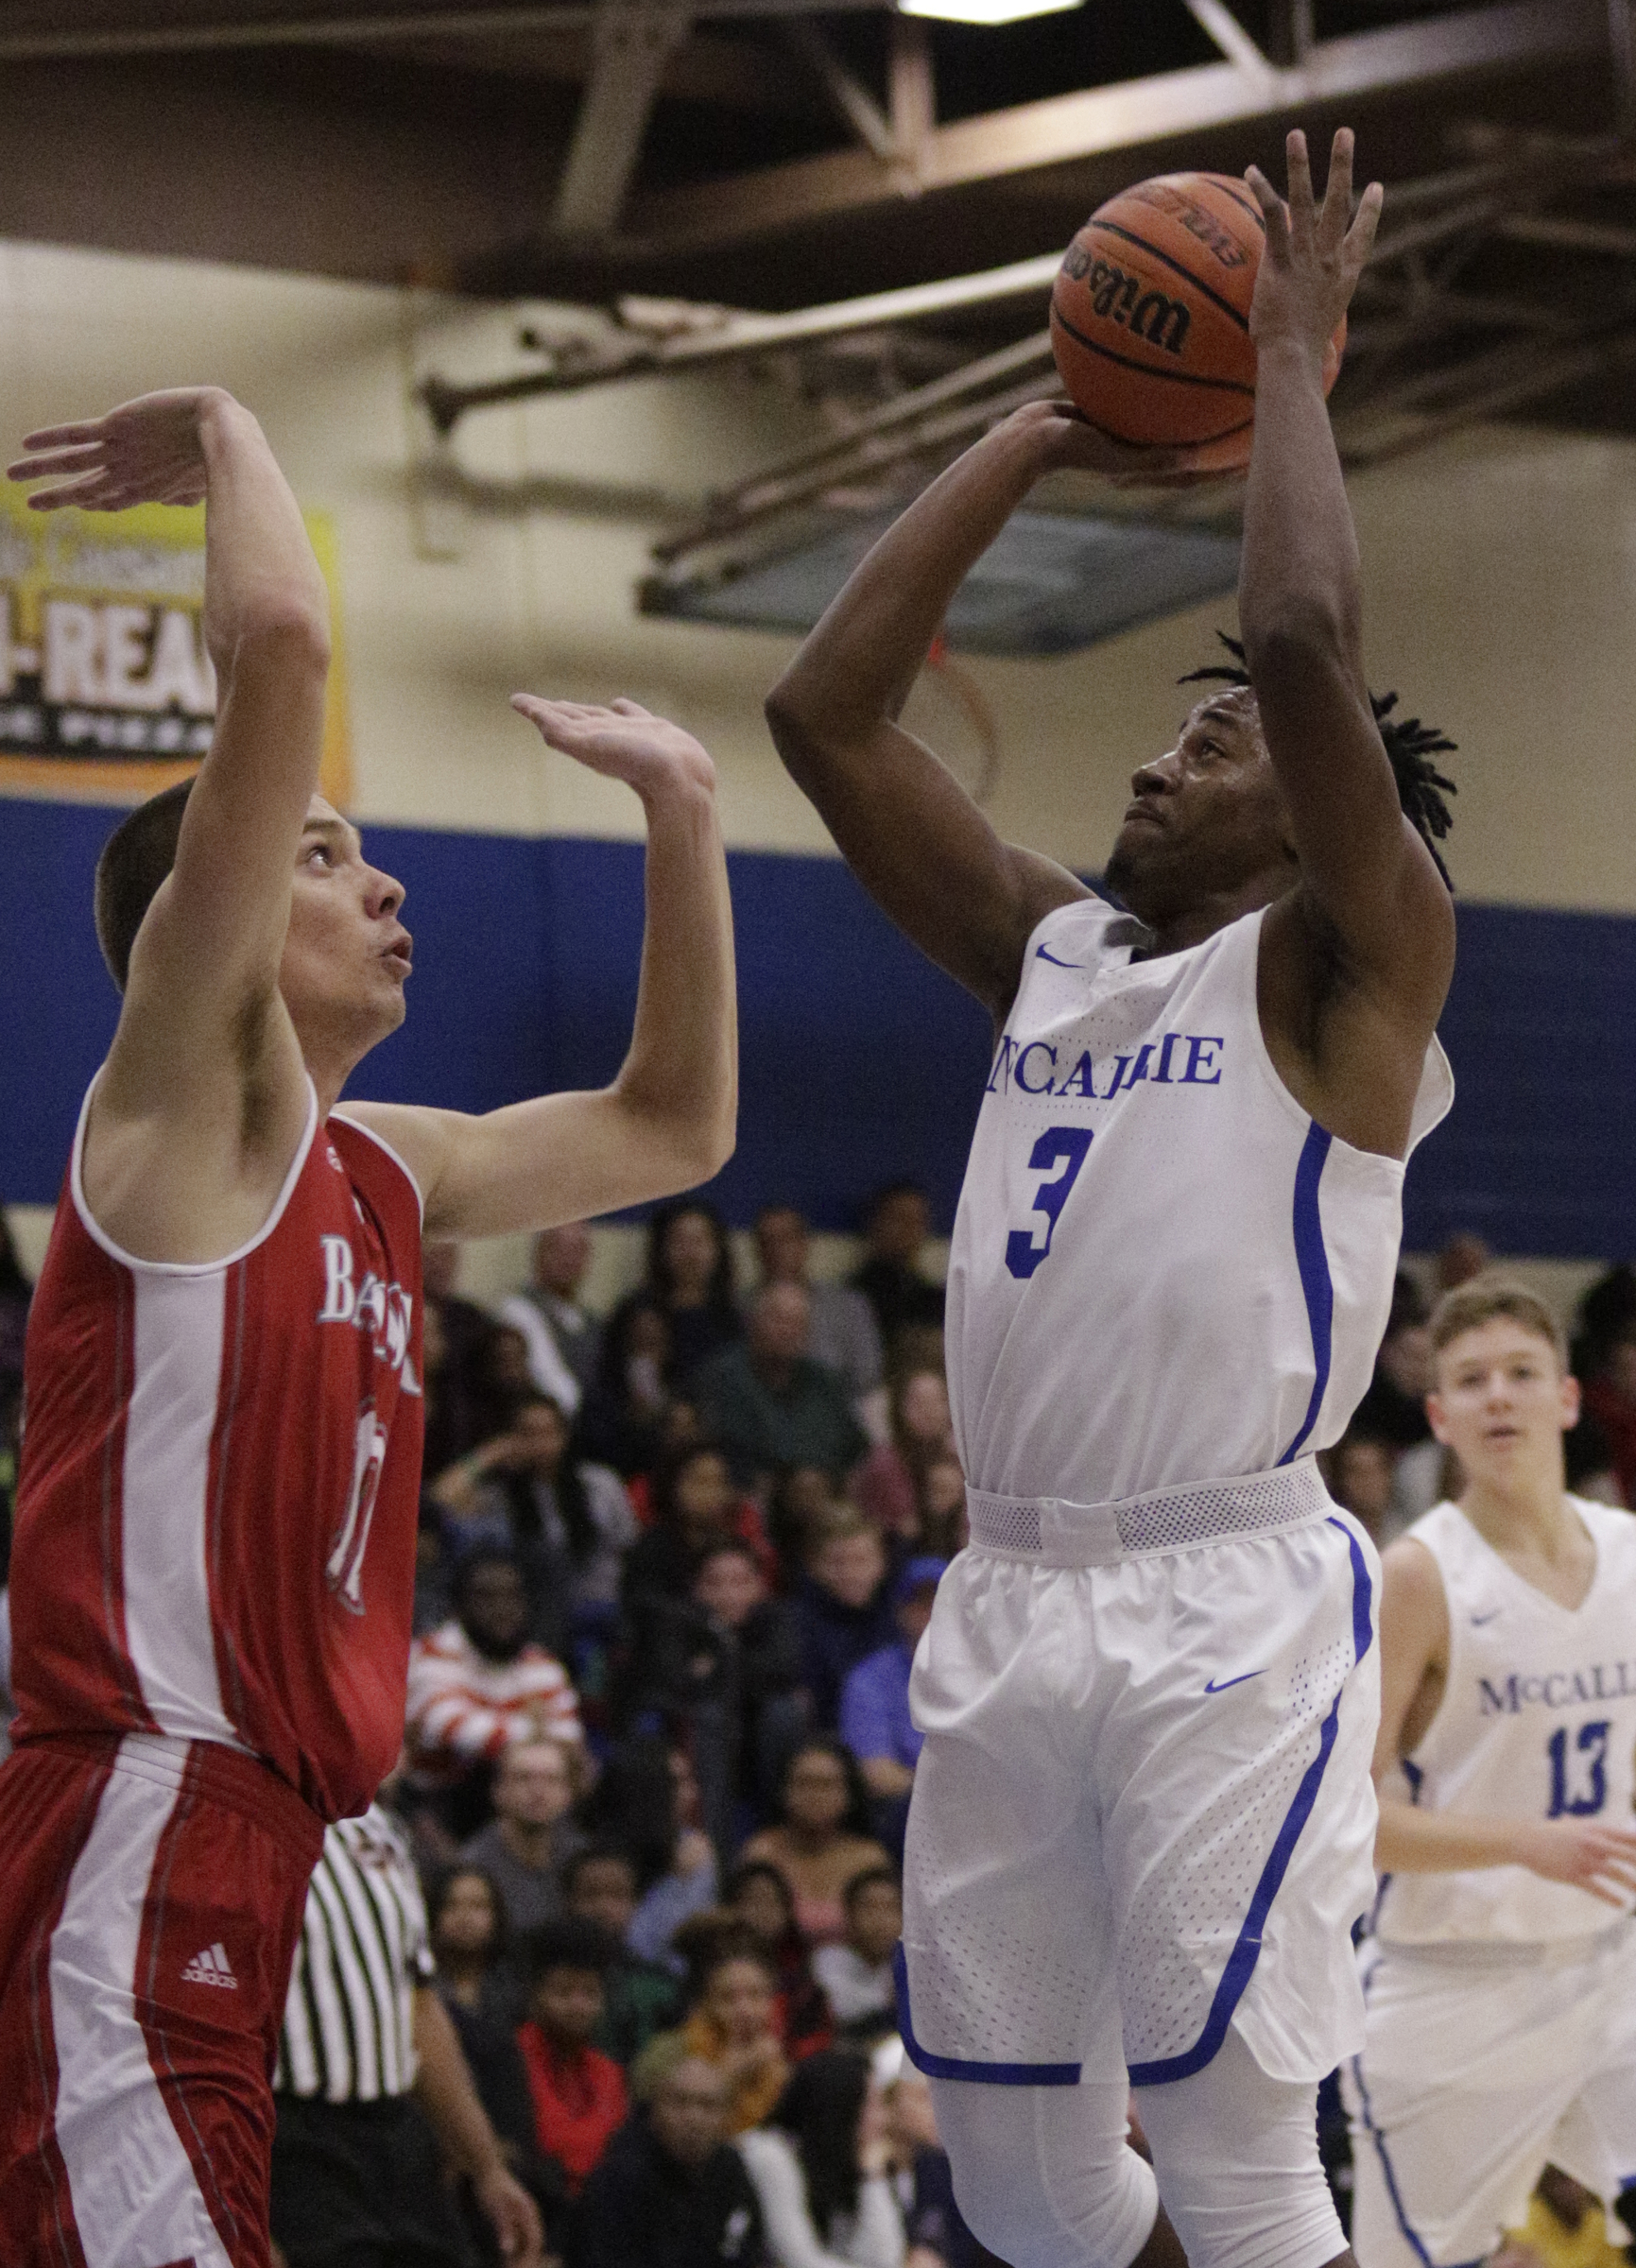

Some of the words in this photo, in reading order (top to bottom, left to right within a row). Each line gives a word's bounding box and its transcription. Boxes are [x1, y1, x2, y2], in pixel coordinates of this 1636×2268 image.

[1005, 1126, 1094, 1279] 3
[1547, 1720, 1611, 1819] 13
[181, 1968, 238, 1989] adidas
